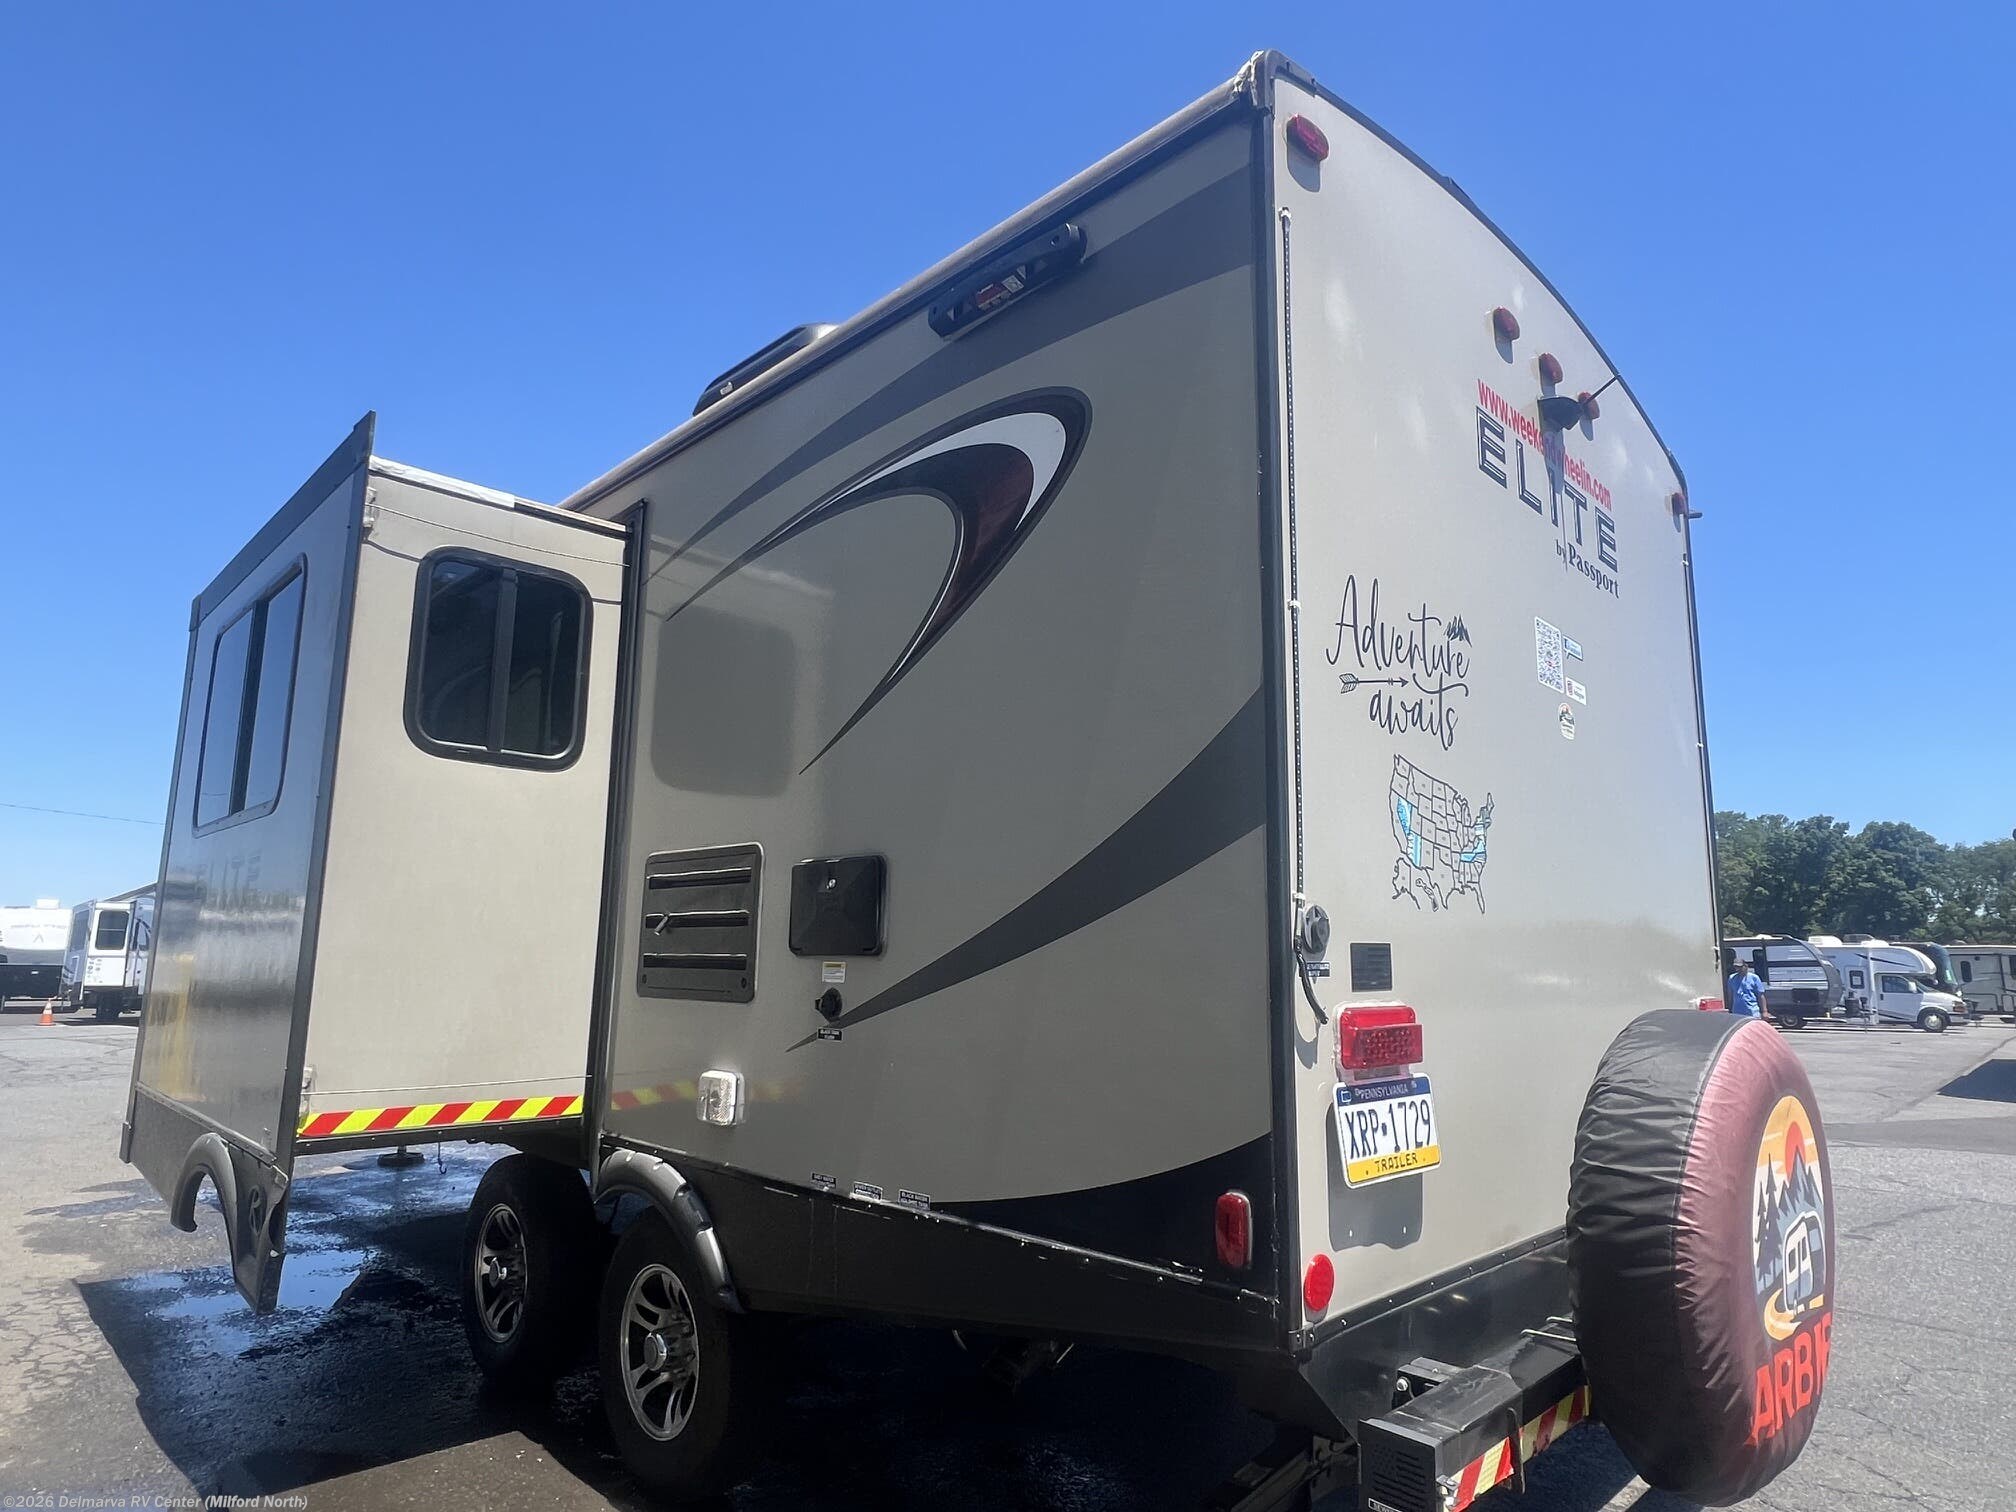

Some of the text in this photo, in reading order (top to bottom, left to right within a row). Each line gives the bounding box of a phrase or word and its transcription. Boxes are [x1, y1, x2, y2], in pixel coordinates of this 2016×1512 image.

[1476, 404, 1618, 573] ELITE
[1555, 539, 1620, 599] by Passport
[1326, 574, 1470, 679] Adventure
[1369, 672, 1470, 751] awaits
[1360, 1083, 1409, 1100] PENNSYLVANIA
[1374, 1152, 1418, 1173] TRAILER
